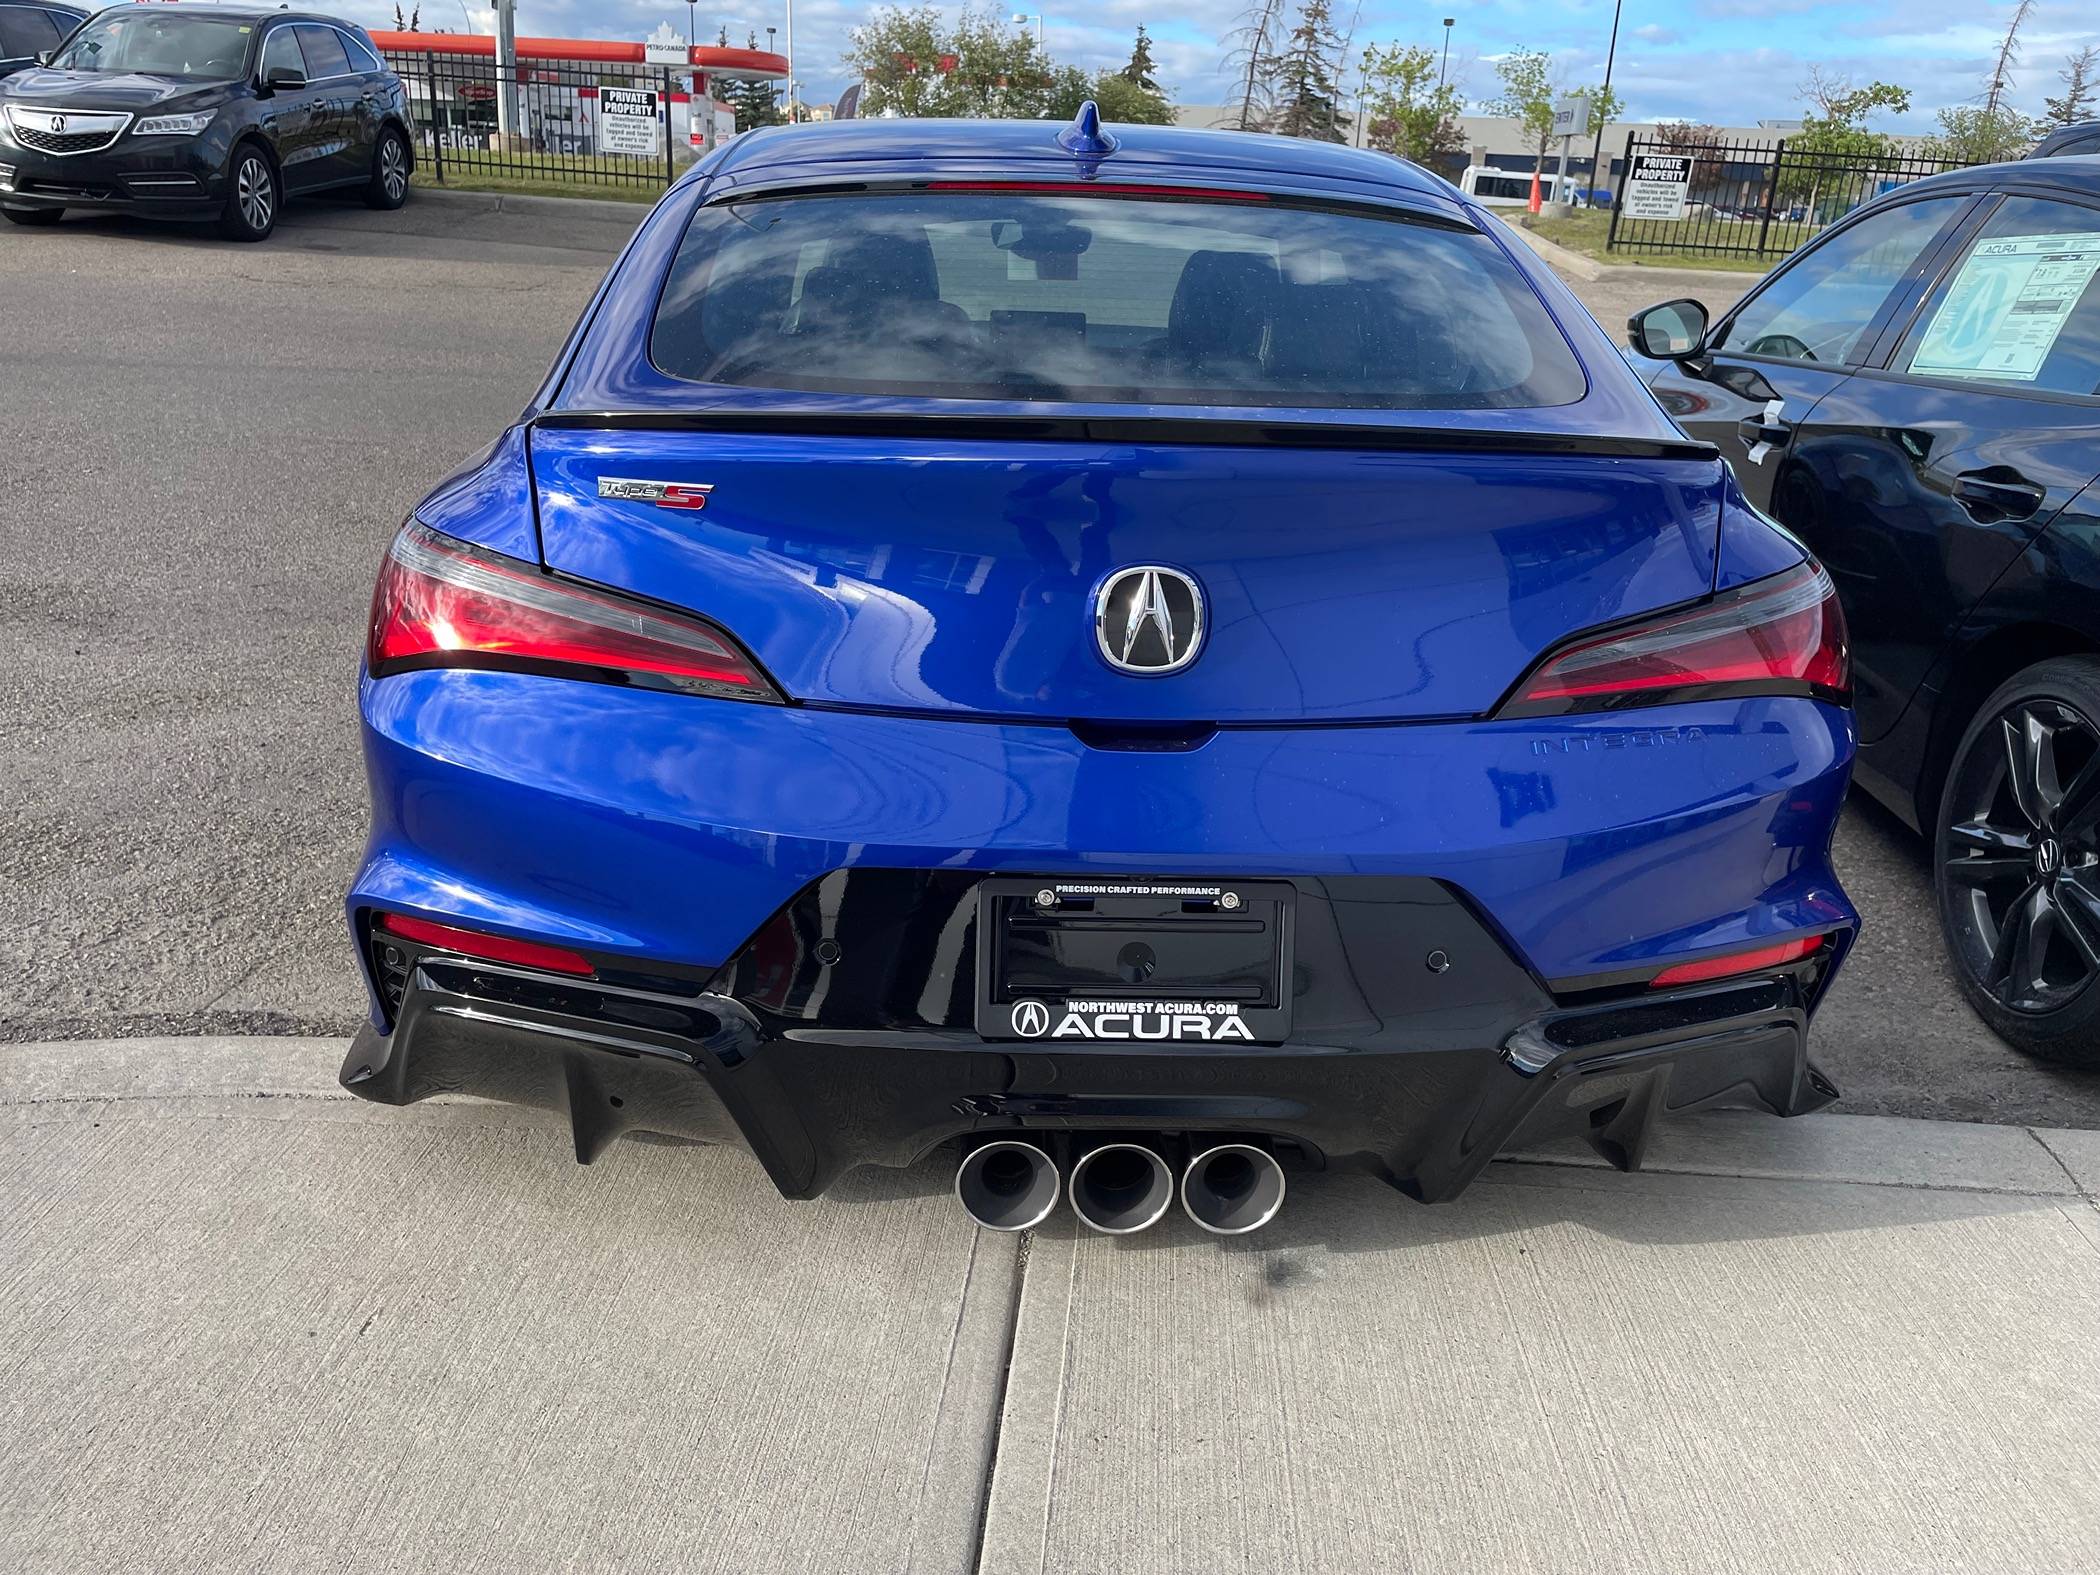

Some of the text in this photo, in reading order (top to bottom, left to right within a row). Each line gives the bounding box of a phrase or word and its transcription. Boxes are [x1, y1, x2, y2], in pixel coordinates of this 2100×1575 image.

[609, 91, 648, 104] PRIVATE
[604, 102, 652, 116] PROPERTY
[611, 115, 647, 123] Unauthorized
[606, 128, 625, 136] tagged
[1642, 157, 1683, 170] PRIVATE
[1635, 168, 1685, 181] PROPERTY
[1984, 244, 2017, 254] ACURA
[655, 484, 713, 511] S
[1530, 727, 1709, 755] INTEGRA
[1055, 885, 1221, 896] PRECISION CRAFTED PERFORMANCE
[1068, 1001, 1239, 1015] NORTHWEST ACURA.COM
[1051, 1013, 1256, 1040] ACURA
